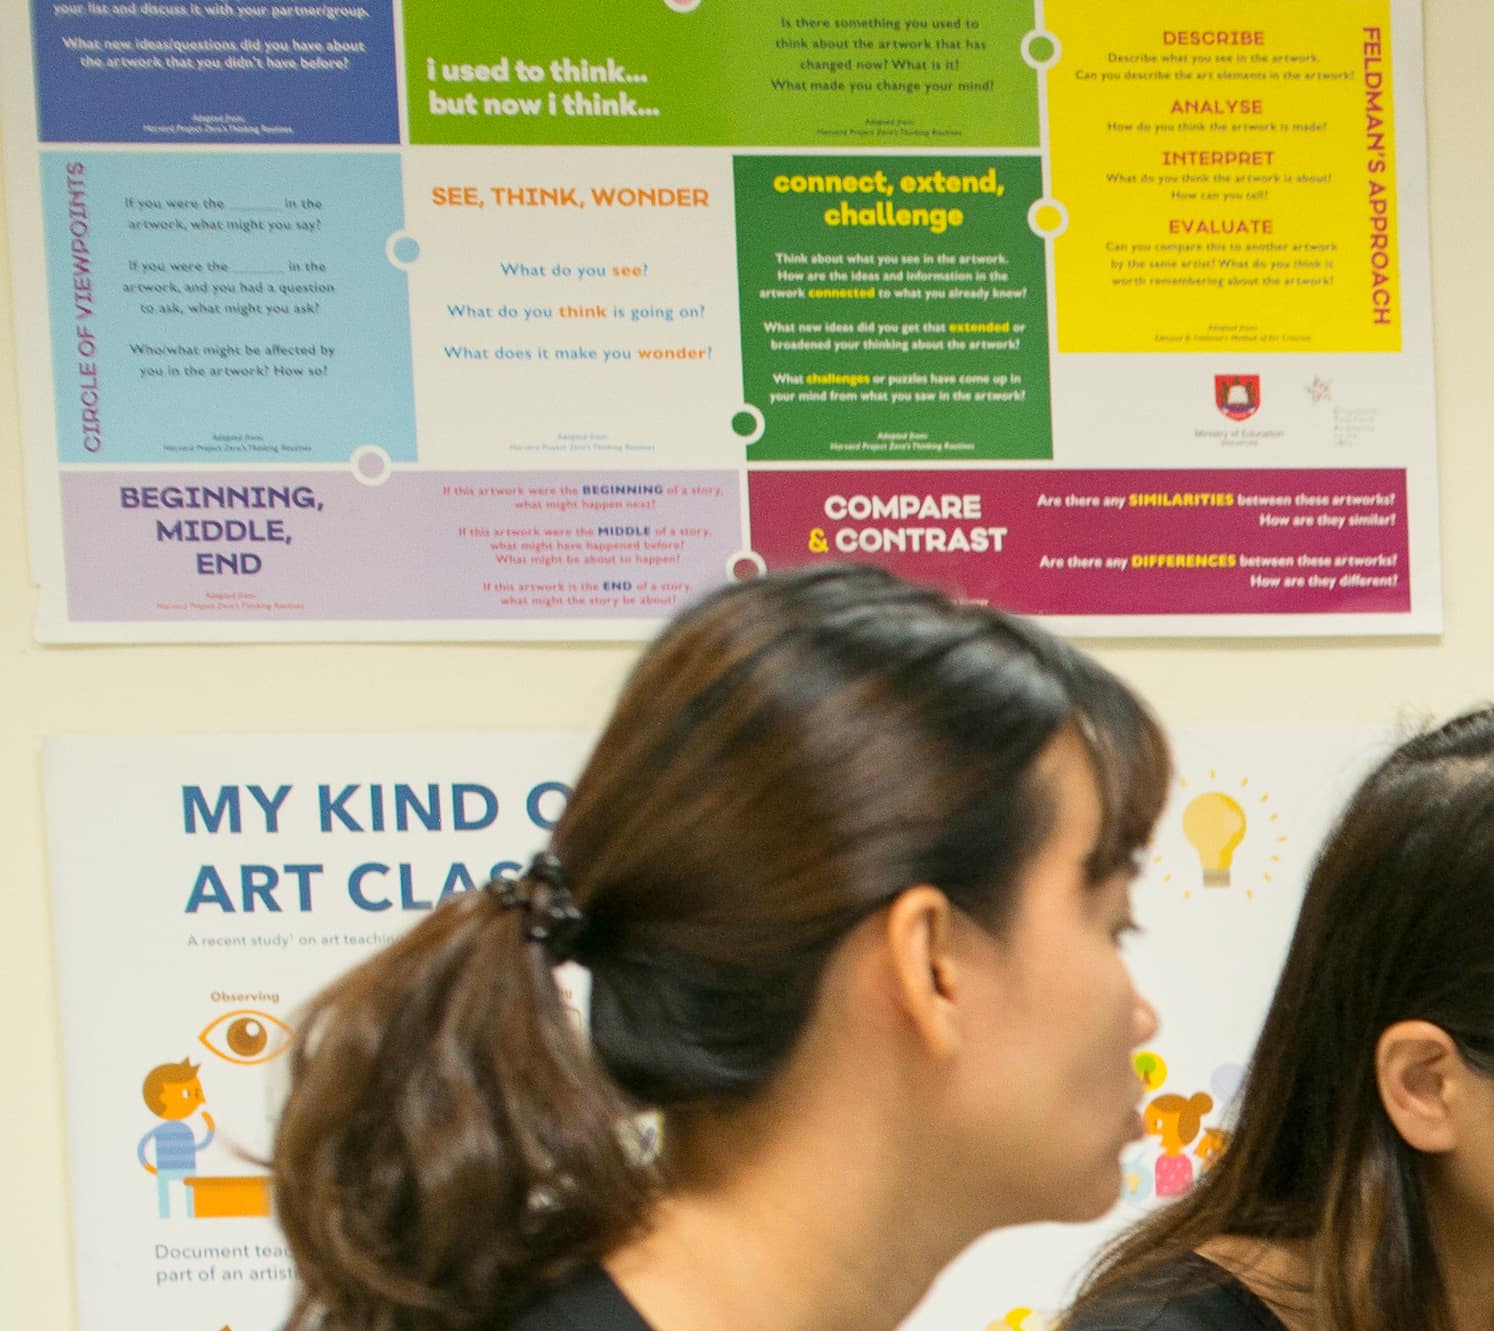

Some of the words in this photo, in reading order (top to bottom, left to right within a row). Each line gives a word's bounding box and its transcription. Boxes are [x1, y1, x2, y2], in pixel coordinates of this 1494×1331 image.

[1163, 31, 1263, 45] DESCRIBE
[427, 57, 436, 80] i
[442, 57, 509, 82] used
[514, 60, 545, 82] to
[549, 57, 647, 82] think...
[428, 90, 477, 115] but
[483, 98, 542, 115] now
[548, 92, 556, 115] i
[561, 91, 659, 116] think...
[1171, 99, 1261, 114] ANALYSE
[1362, 26, 1388, 174] FELDMAN'S
[1163, 151, 1273, 165] INTERPRET
[773, 170, 893, 196] connect,
[900, 167, 1004, 196] extend,
[432, 187, 484, 207] SEE,
[491, 187, 583, 208] THINK,
[591, 188, 708, 206] WONDER
[824, 202, 963, 233] challenge
[1169, 219, 1271, 234] EVALUATE
[66, 161, 93, 320] VIEWPOINTS
[1368, 179, 1391, 324] APPROACH
[500, 263, 544, 276] What
[552, 264, 571, 276] do
[578, 267, 605, 279] you
[612, 264, 647, 276] see?
[447, 305, 491, 317] What
[498, 305, 517, 317] do
[524, 308, 551, 320] you
[559, 305, 606, 318] think
[613, 307, 624, 317] is
[631, 307, 673, 320] going
[679, 305, 704, 317] on?
[78, 328, 96, 362] OF
[444, 346, 487, 359] What
[494, 346, 531, 358] does
[538, 348, 547, 358] it
[555, 346, 596, 358] make
[603, 350, 630, 362] you
[638, 346, 711, 359] wonder?
[84, 369, 102, 453] CIRCLE
[120, 486, 323, 511] BEGINNING,
[824, 495, 981, 519] COMPARE
[1037, 494, 1061, 506] Are
[1065, 494, 1099, 506] there
[1103, 496, 1125, 509] any
[1129, 493, 1233, 506] SIMILARITIES
[1237, 493, 1291, 505] between
[1295, 493, 1329, 505] these
[1332, 493, 1395, 505] artworks?
[156, 520, 291, 544] MIDDLE,
[809, 528, 828, 552] &
[835, 527, 1007, 552] CONTRAST
[196, 553, 261, 574] END
[1039, 555, 1063, 567] Are
[1067, 555, 1102, 568] there
[1106, 558, 1127, 570] any
[1131, 554, 1235, 567] DIFFERENCES
[1239, 554, 1294, 567] between
[1297, 554, 1331, 566] these
[1334, 554, 1397, 566] artworks?
[182, 784, 292, 833] MY
[318, 782, 498, 832] KIND
[185, 864, 323, 912] ART
[210, 991, 279, 1003] Observing
[155, 1244, 248, 1259] Document
[156, 1269, 193, 1286] part
[198, 1265, 215, 1281] of
[222, 1269, 243, 1281] an
